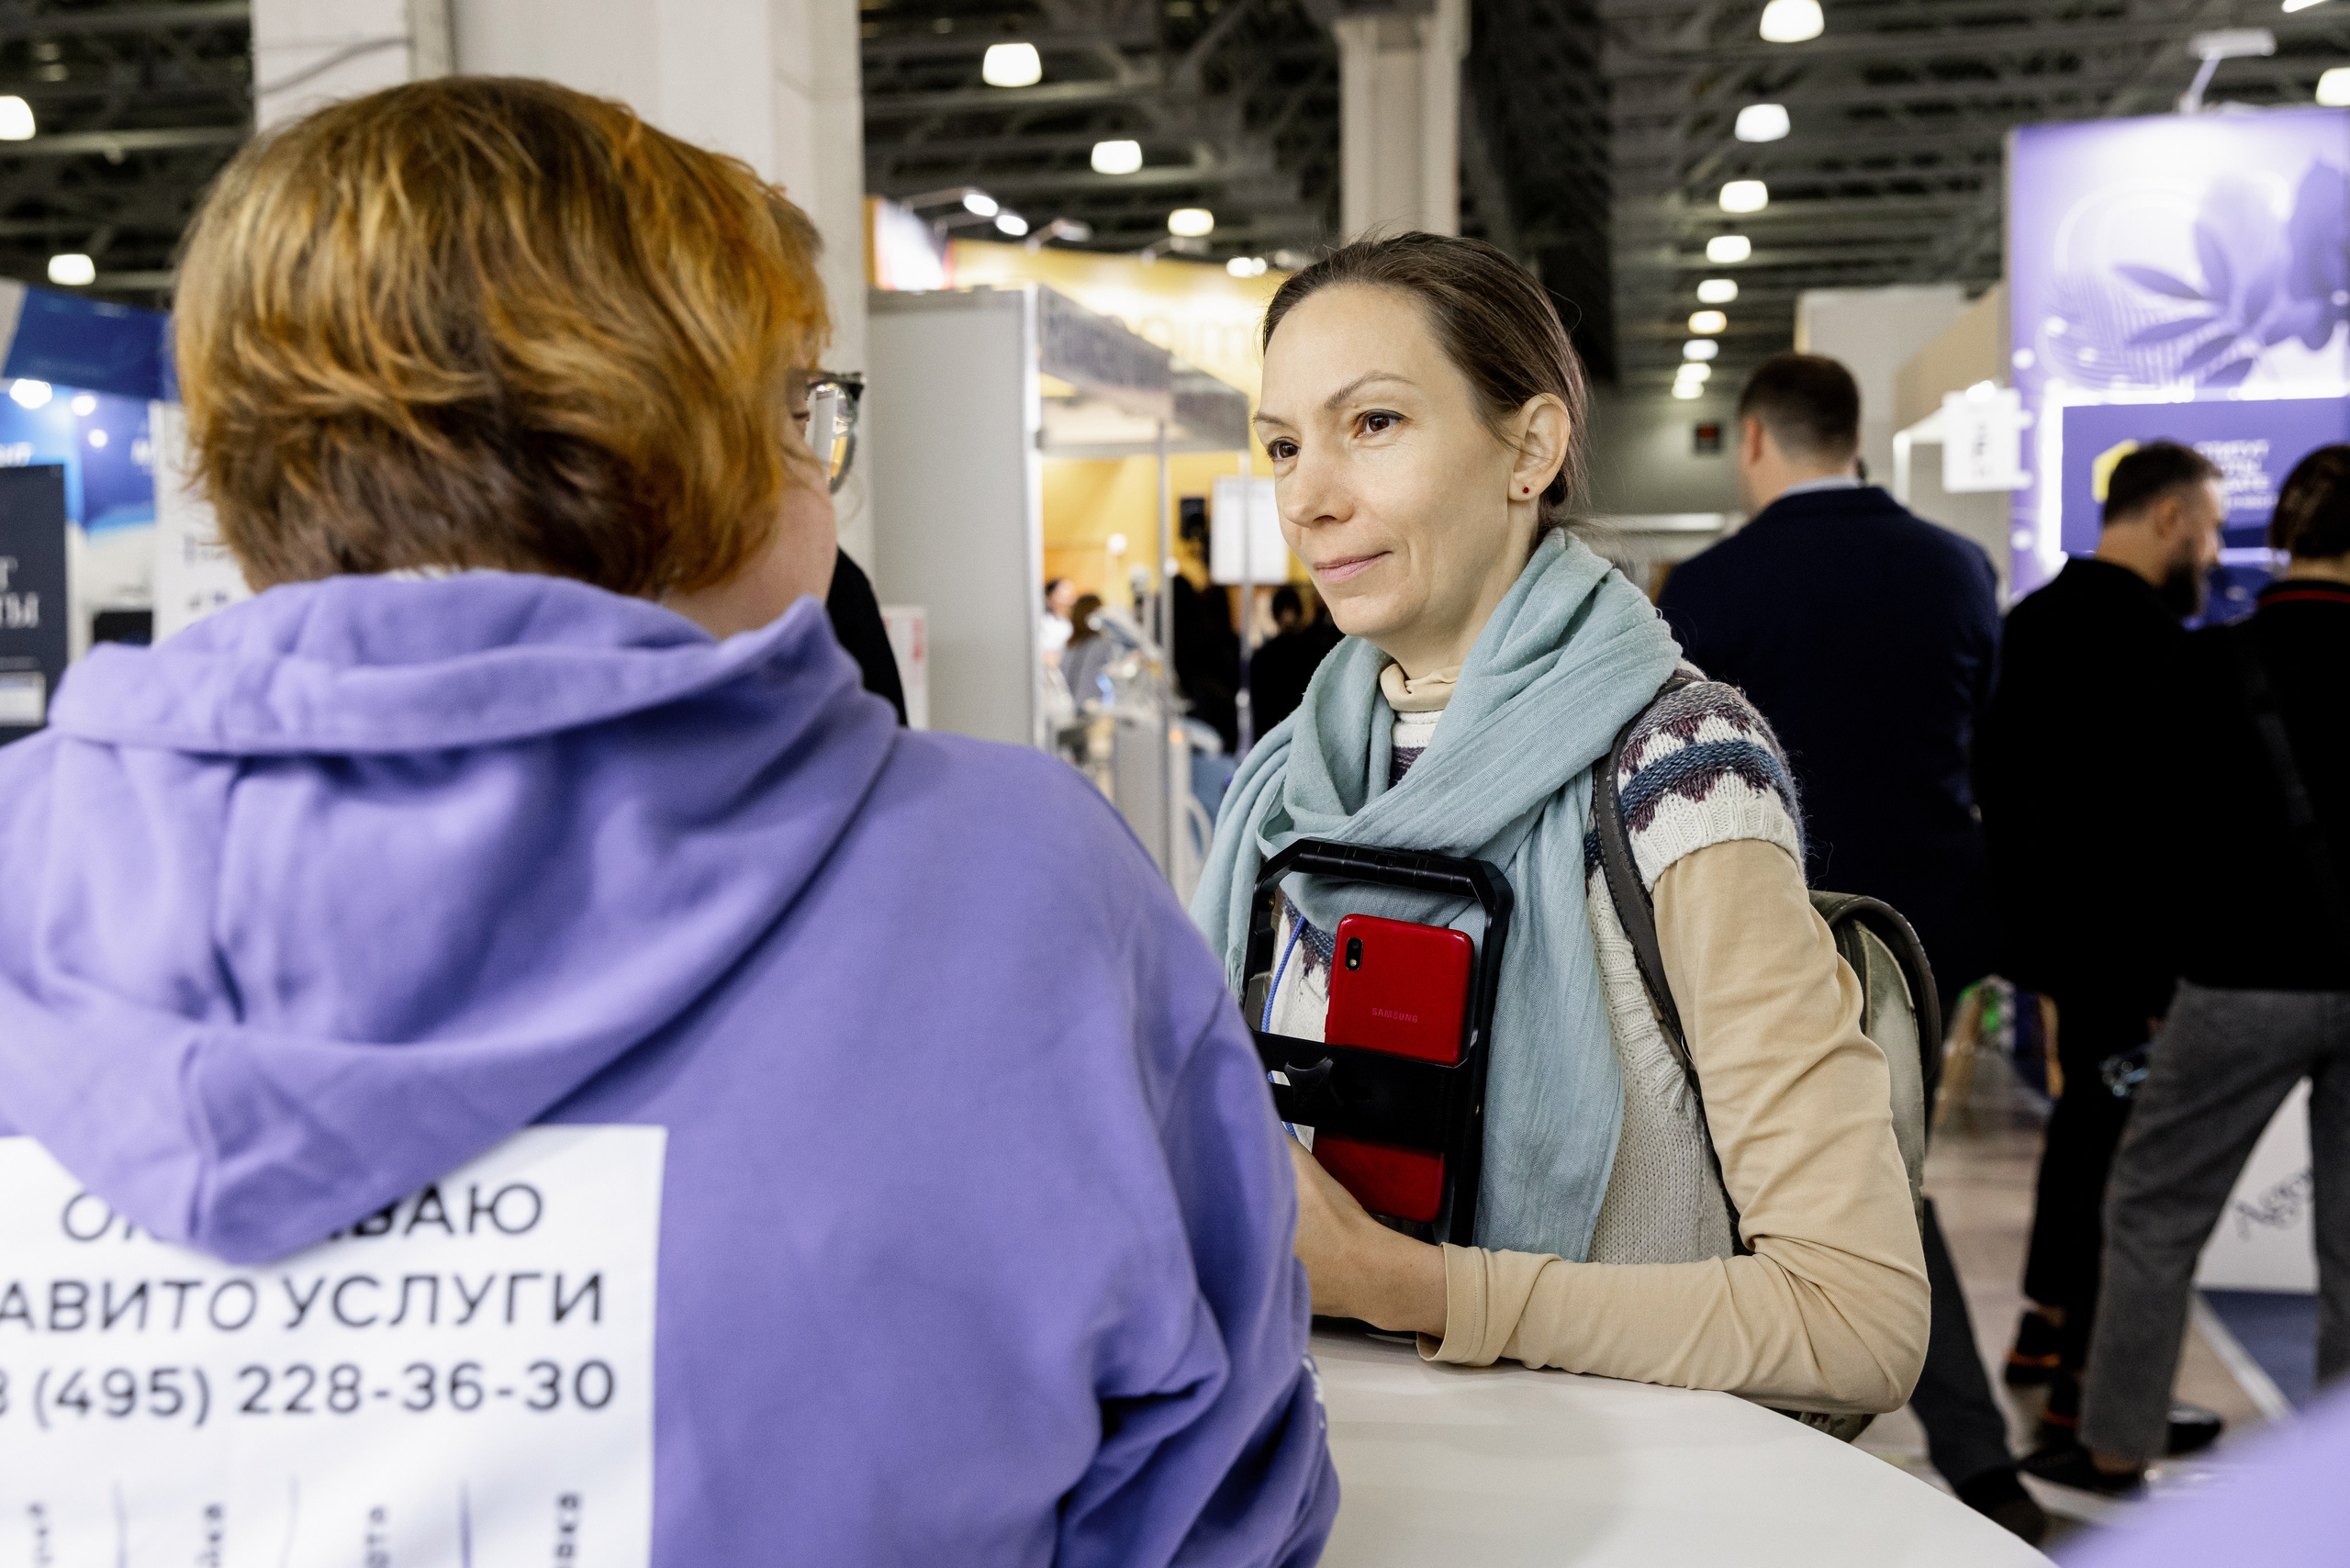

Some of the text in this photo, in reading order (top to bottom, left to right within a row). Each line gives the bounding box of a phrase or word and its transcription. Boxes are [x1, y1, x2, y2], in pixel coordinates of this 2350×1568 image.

[1371, 1007, 1418, 1024] SAMSUNG
[0, 1271, 603, 1332] АВИТО УСЛУГИ
[33, 1365, 211, 1430] (495)
[236, 1359, 615, 1417] 228-36-30
